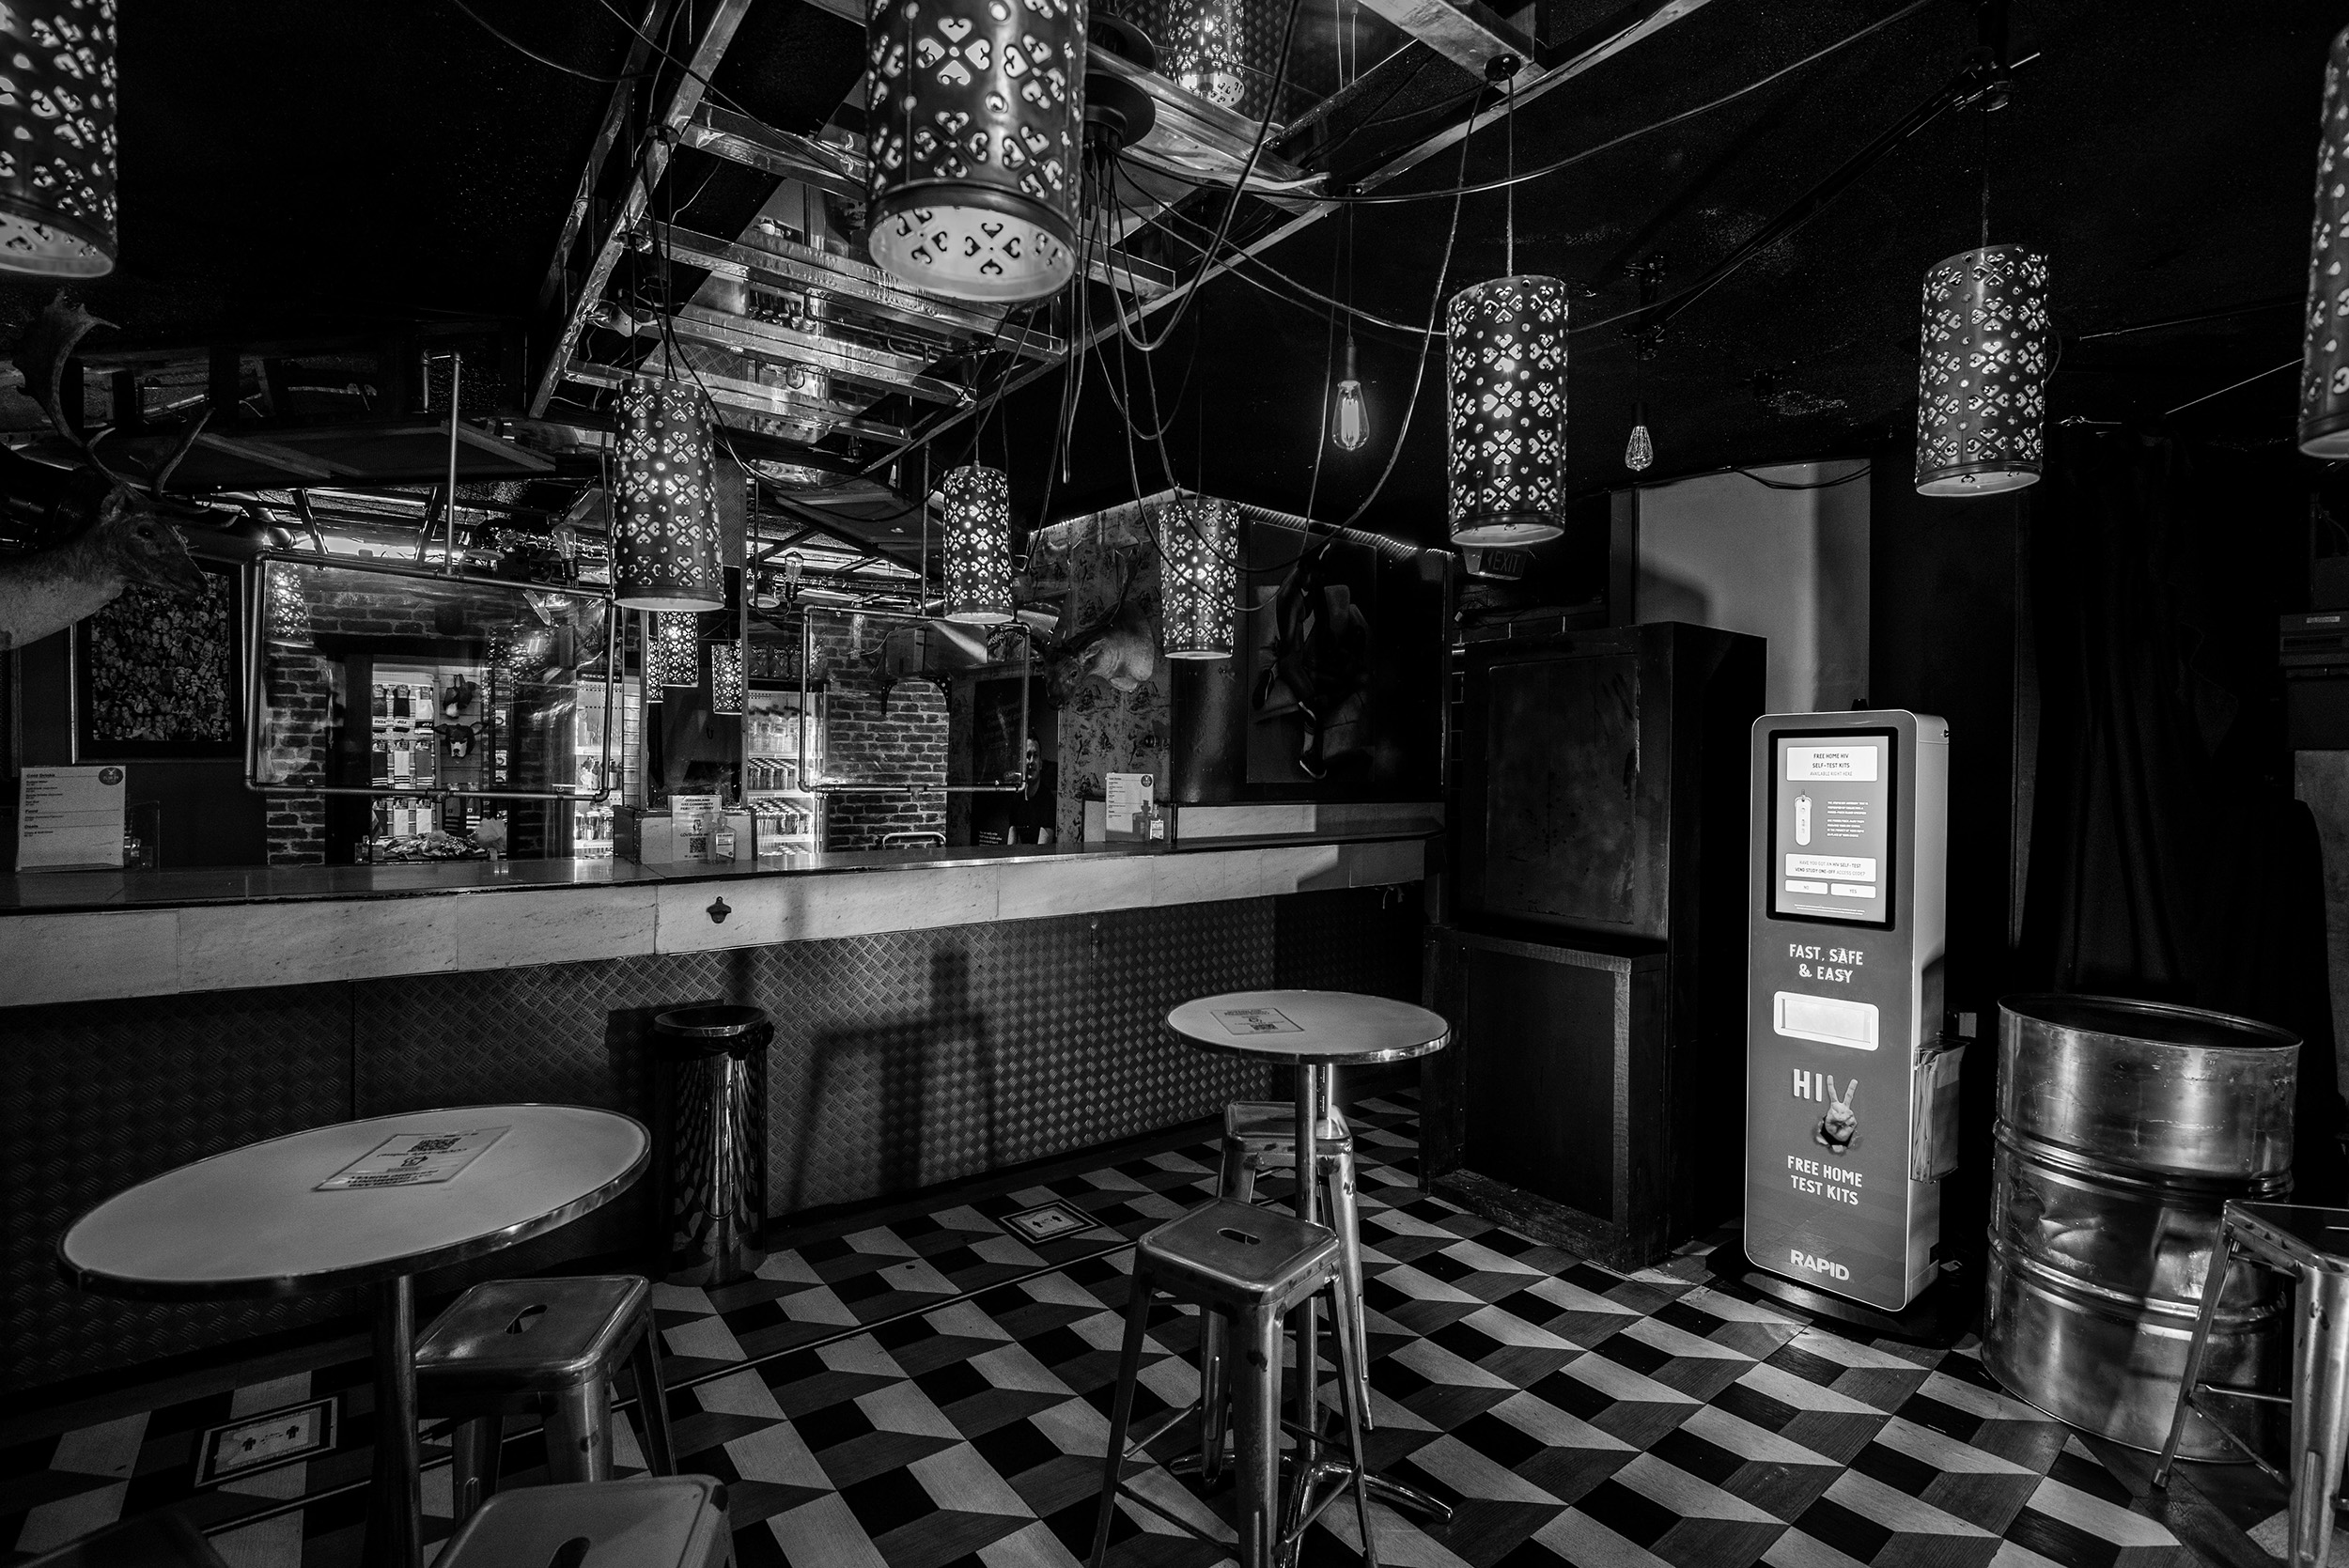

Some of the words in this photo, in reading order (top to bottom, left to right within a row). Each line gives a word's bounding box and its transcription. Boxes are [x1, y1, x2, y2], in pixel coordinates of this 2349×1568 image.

[1492, 551, 1521, 573] EXIT
[1789, 943, 1825, 962] FAST,
[1828, 947, 1864, 966] SAFE
[1798, 963, 1812, 978] &
[1816, 966, 1854, 984] EASY
[1787, 1155, 1819, 1176] FREE
[1823, 1164, 1863, 1188] HOME
[1791, 1174, 1823, 1195] TEST
[1827, 1184, 1859, 1205] KITS
[1790, 1249, 1849, 1281] RAPID
